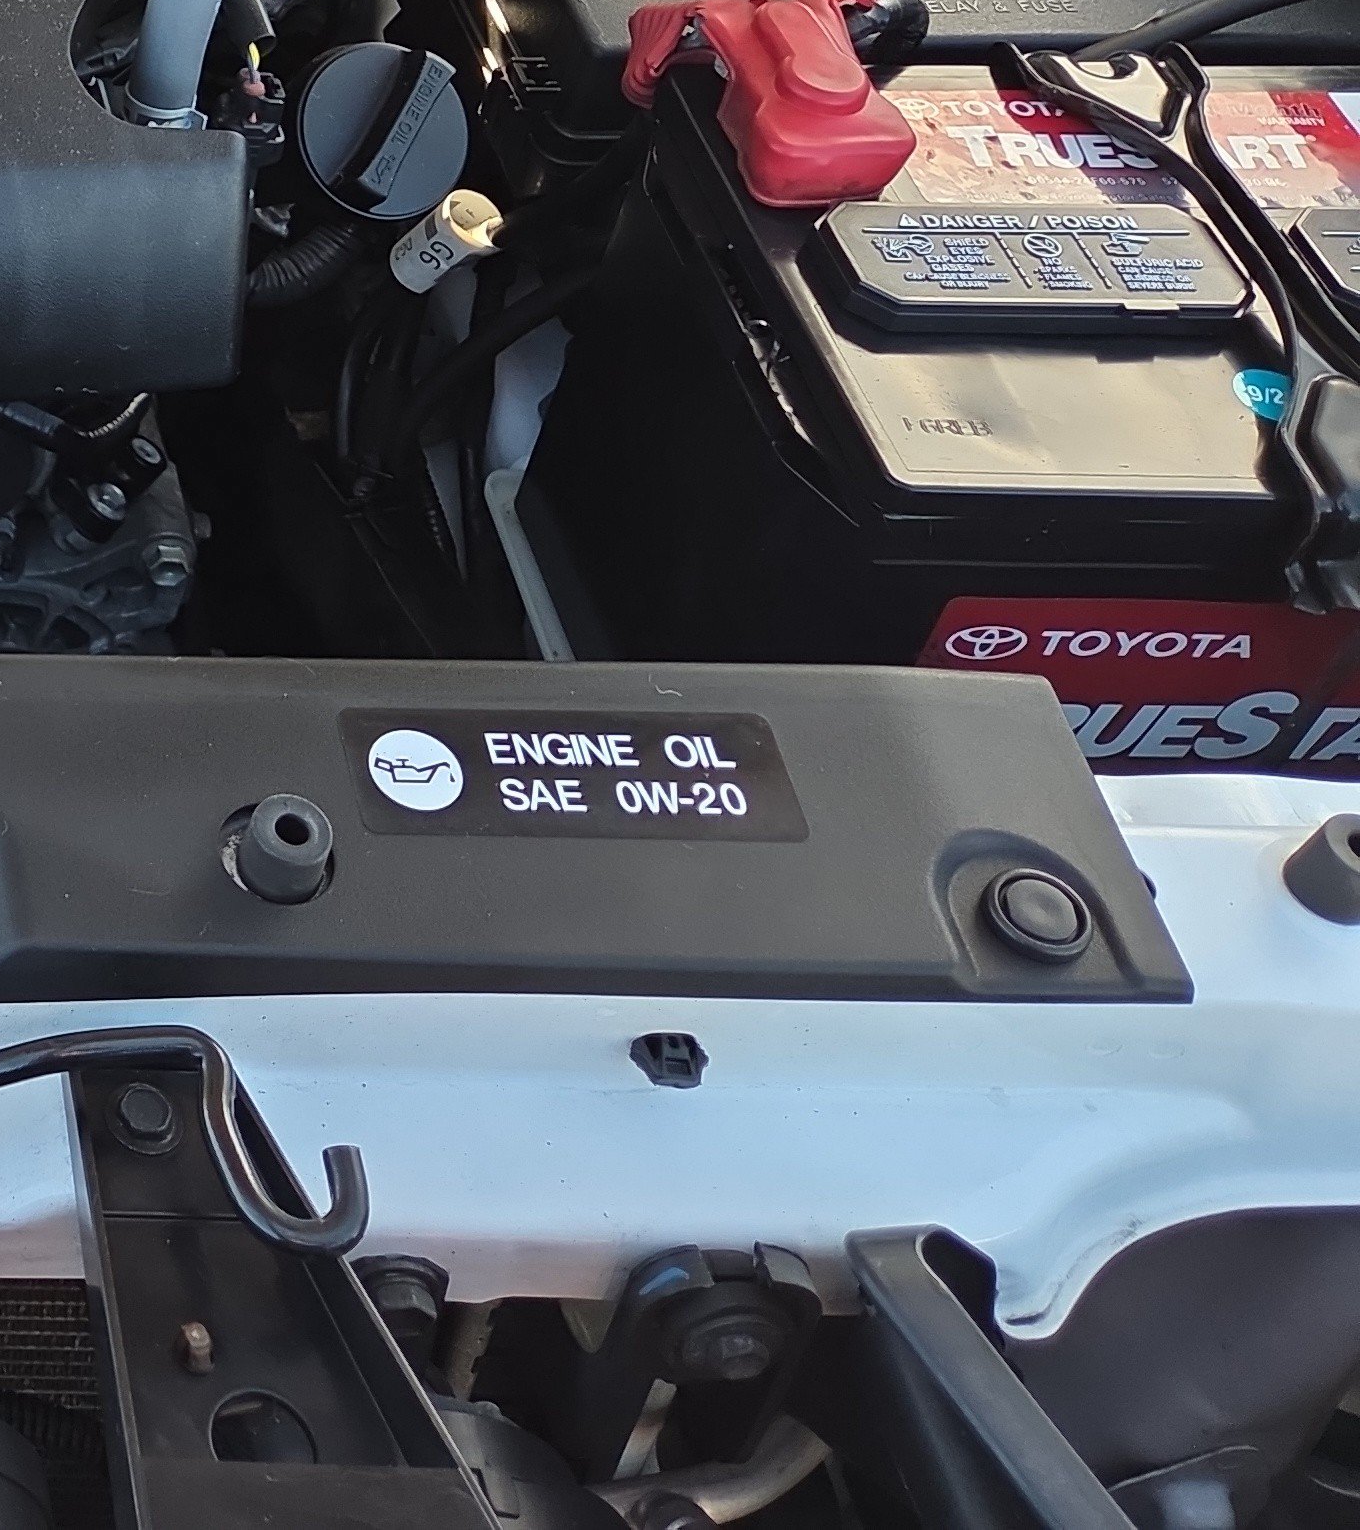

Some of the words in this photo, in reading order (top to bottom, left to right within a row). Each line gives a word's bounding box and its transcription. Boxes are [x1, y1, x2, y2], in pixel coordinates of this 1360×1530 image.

[925, 0, 980, 13] ELAY
[992, 0, 1010, 13] &
[1017, 0, 1079, 13] FUSE
[390, 122, 412, 145] OIL
[921, 214, 1024, 230] DANGER
[1049, 215, 1139, 231] POISON
[944, 238, 990, 247] SHIELD
[949, 247, 984, 255] EYES
[925, 255, 996, 265] EXPLOSIVE
[1041, 258, 1062, 267] NO
[1111, 258, 1173, 268] SULFURIC
[1175, 259, 1204, 269] ACID
[930, 264, 975, 273] GASES
[1040, 631, 1252, 659] TOYOTA
[483, 732, 640, 766] ENGINE
[664, 735, 737, 769] OIL
[500, 778, 588, 812] SAE
[615, 780, 747, 816] 0W-20
